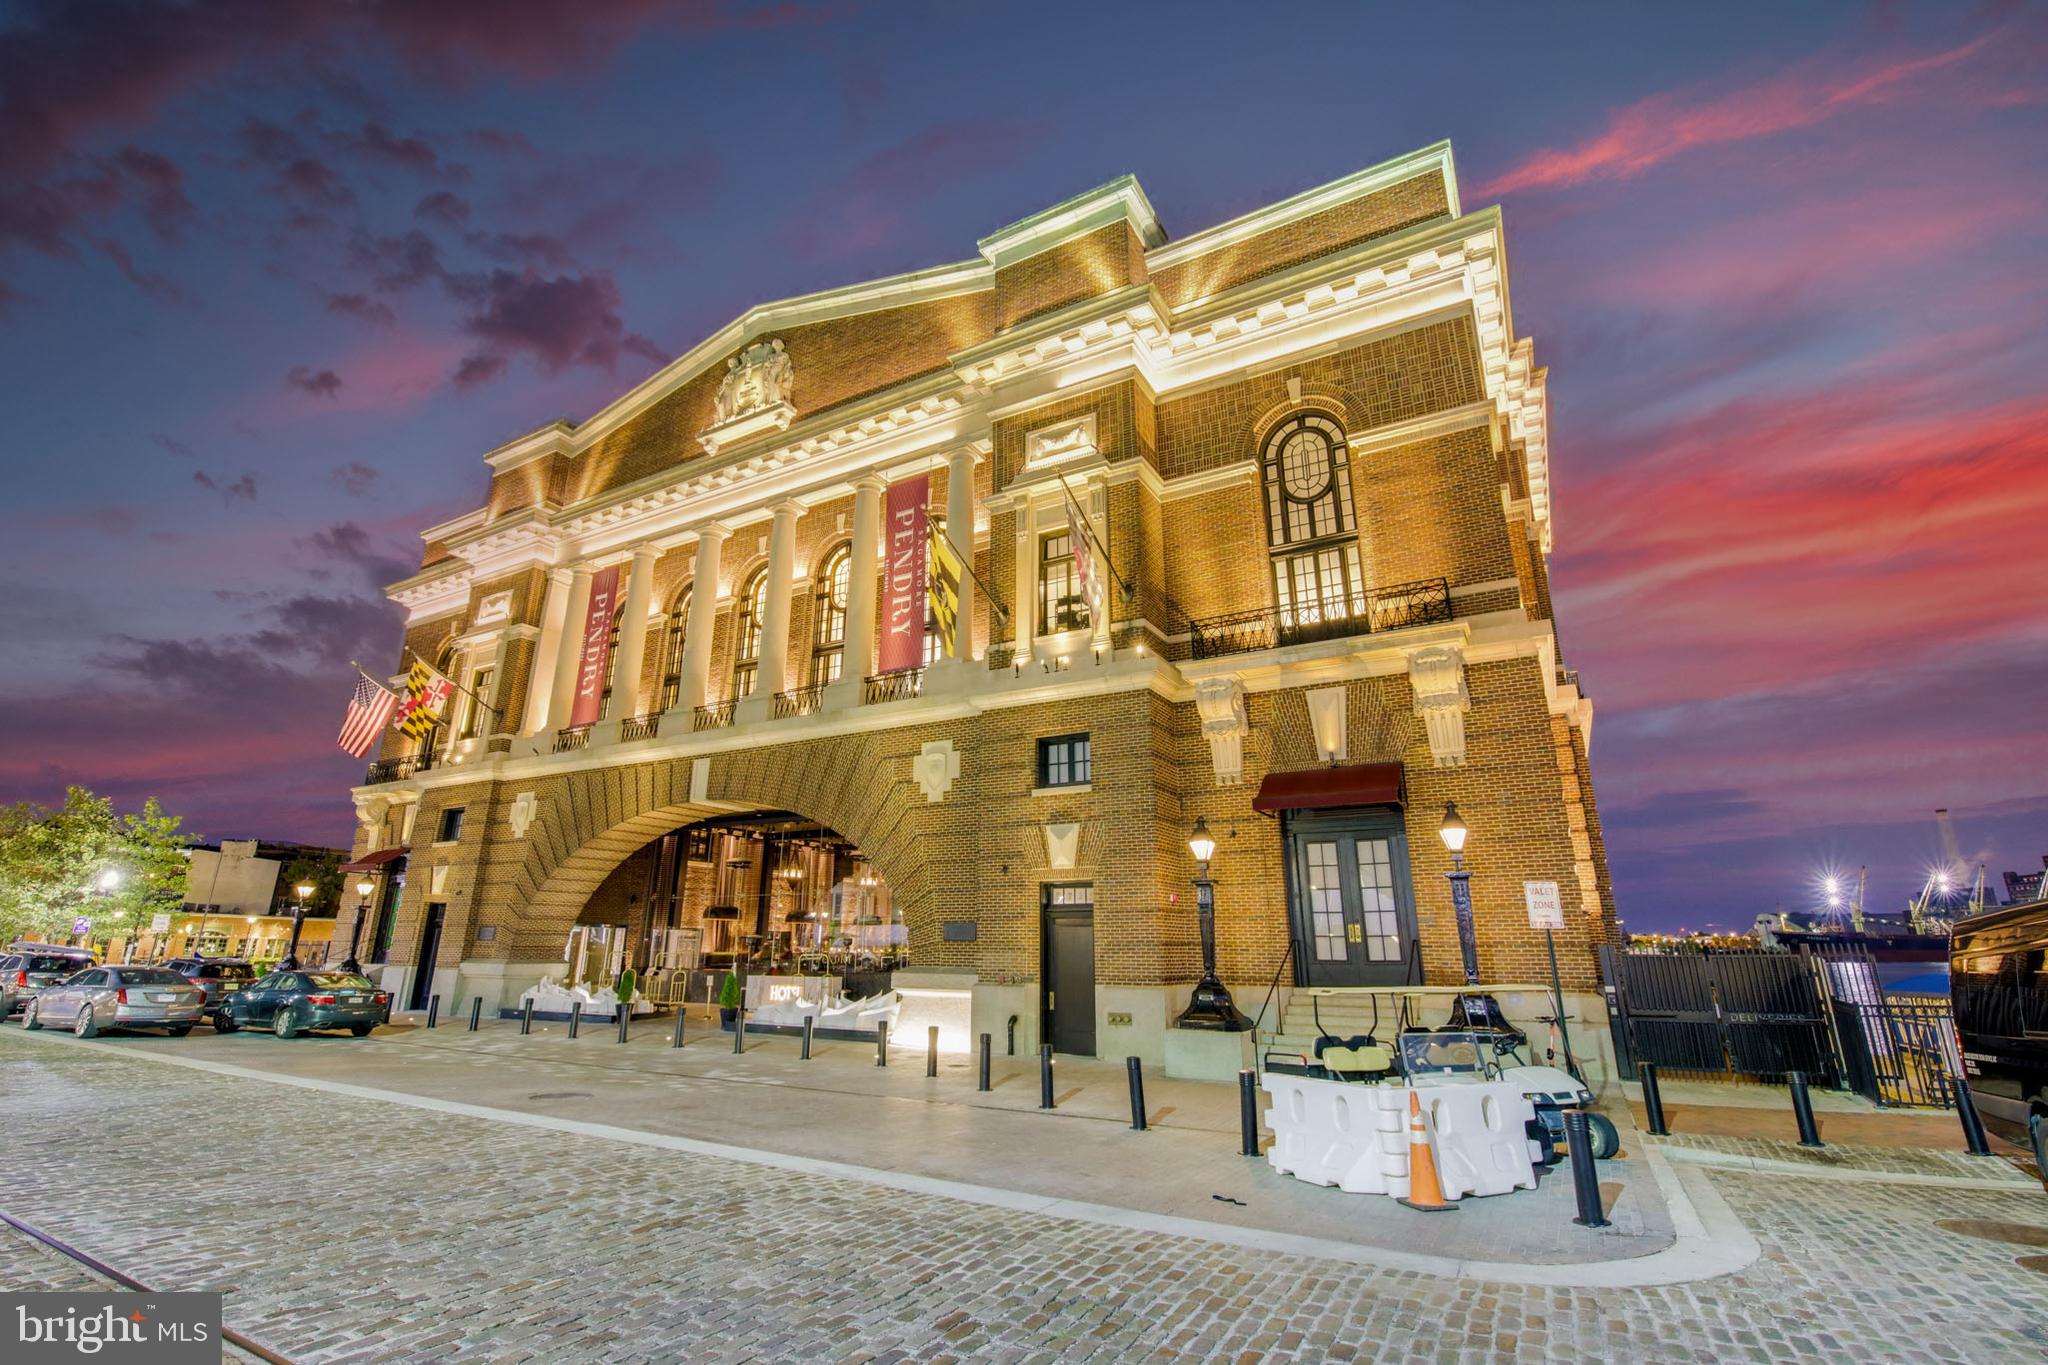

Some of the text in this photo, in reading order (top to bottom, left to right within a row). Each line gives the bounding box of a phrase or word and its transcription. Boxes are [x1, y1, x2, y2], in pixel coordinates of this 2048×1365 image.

[890, 506, 915, 637] PENDRY
[580, 592, 609, 699] PENDRY
[1528, 887, 1554, 896] VALET
[1533, 901, 1555, 909] ZONE
